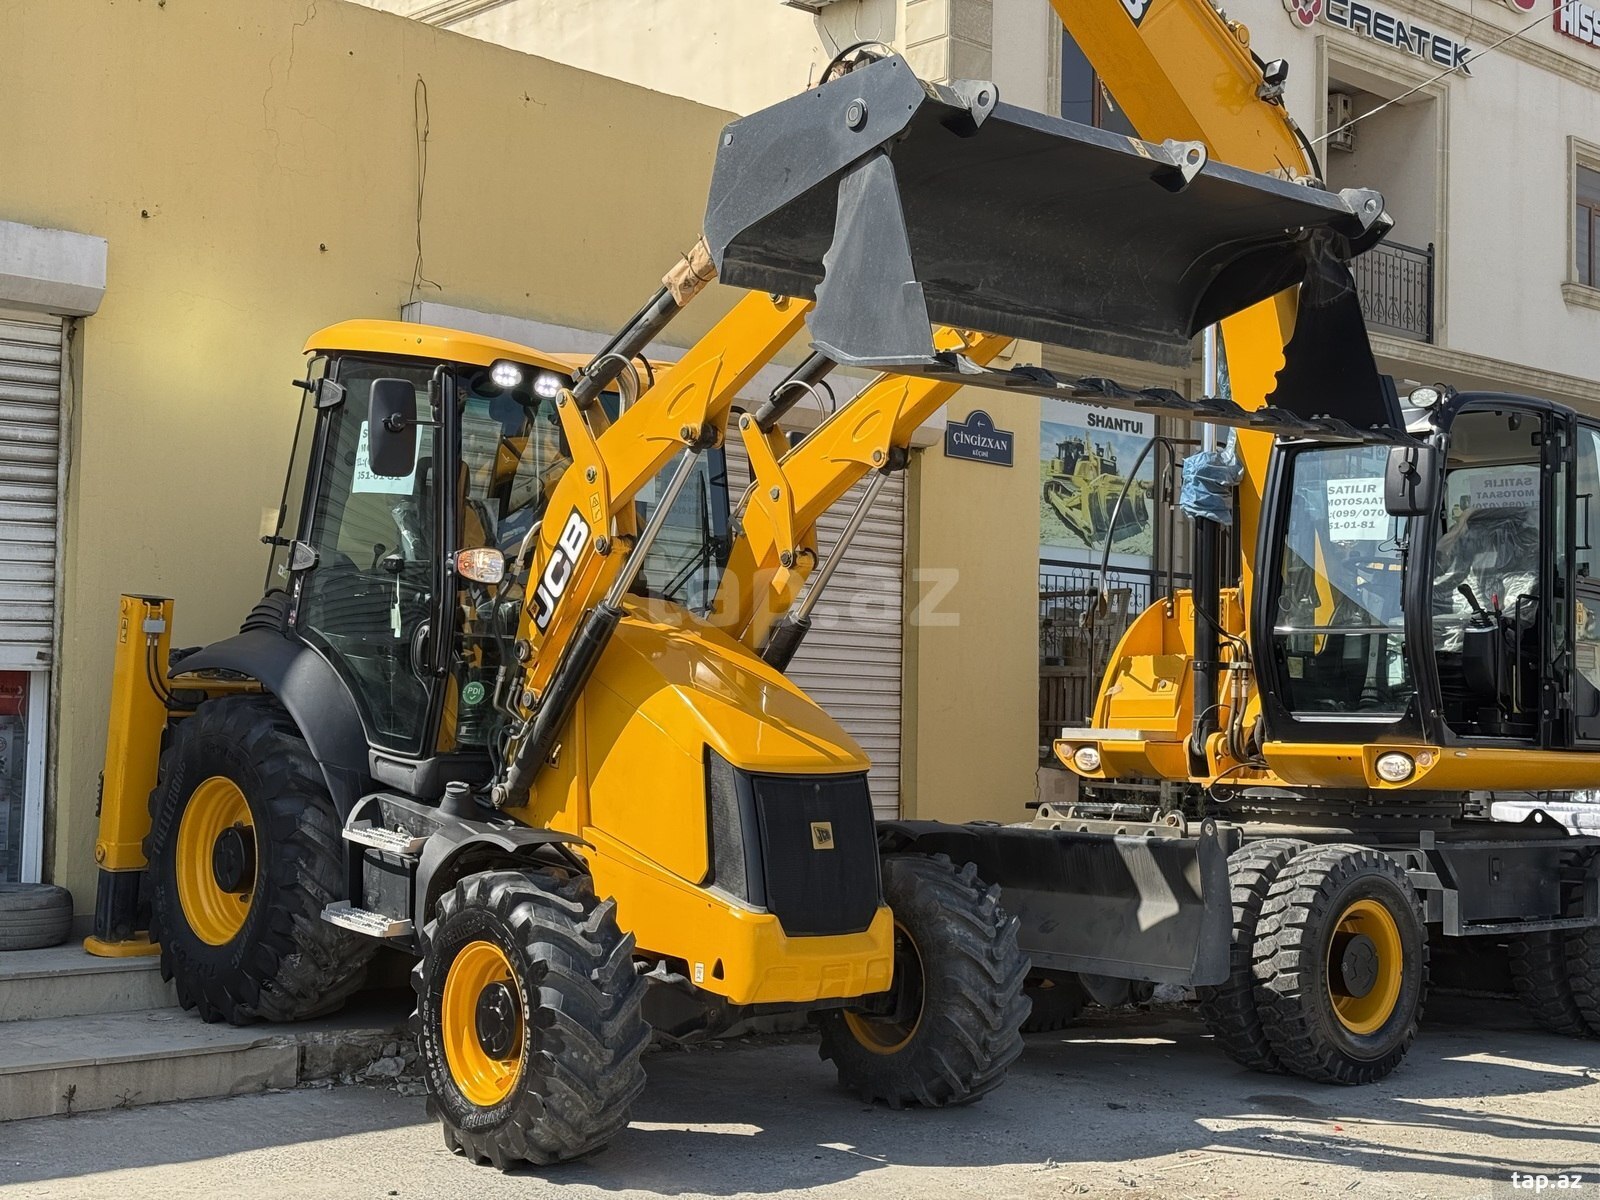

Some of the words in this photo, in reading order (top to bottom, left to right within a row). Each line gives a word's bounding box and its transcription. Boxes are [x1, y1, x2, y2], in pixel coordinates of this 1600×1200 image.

[1325, 0, 1472, 77] CREATEK
[1087, 412, 1143, 434] SHANTUI
[953, 431, 1008, 451] ÇİNGİZXAN
[1328, 484, 1377, 495] SATILIR
[537, 512, 589, 629] JCB
[467, 686, 481, 695] PDI
